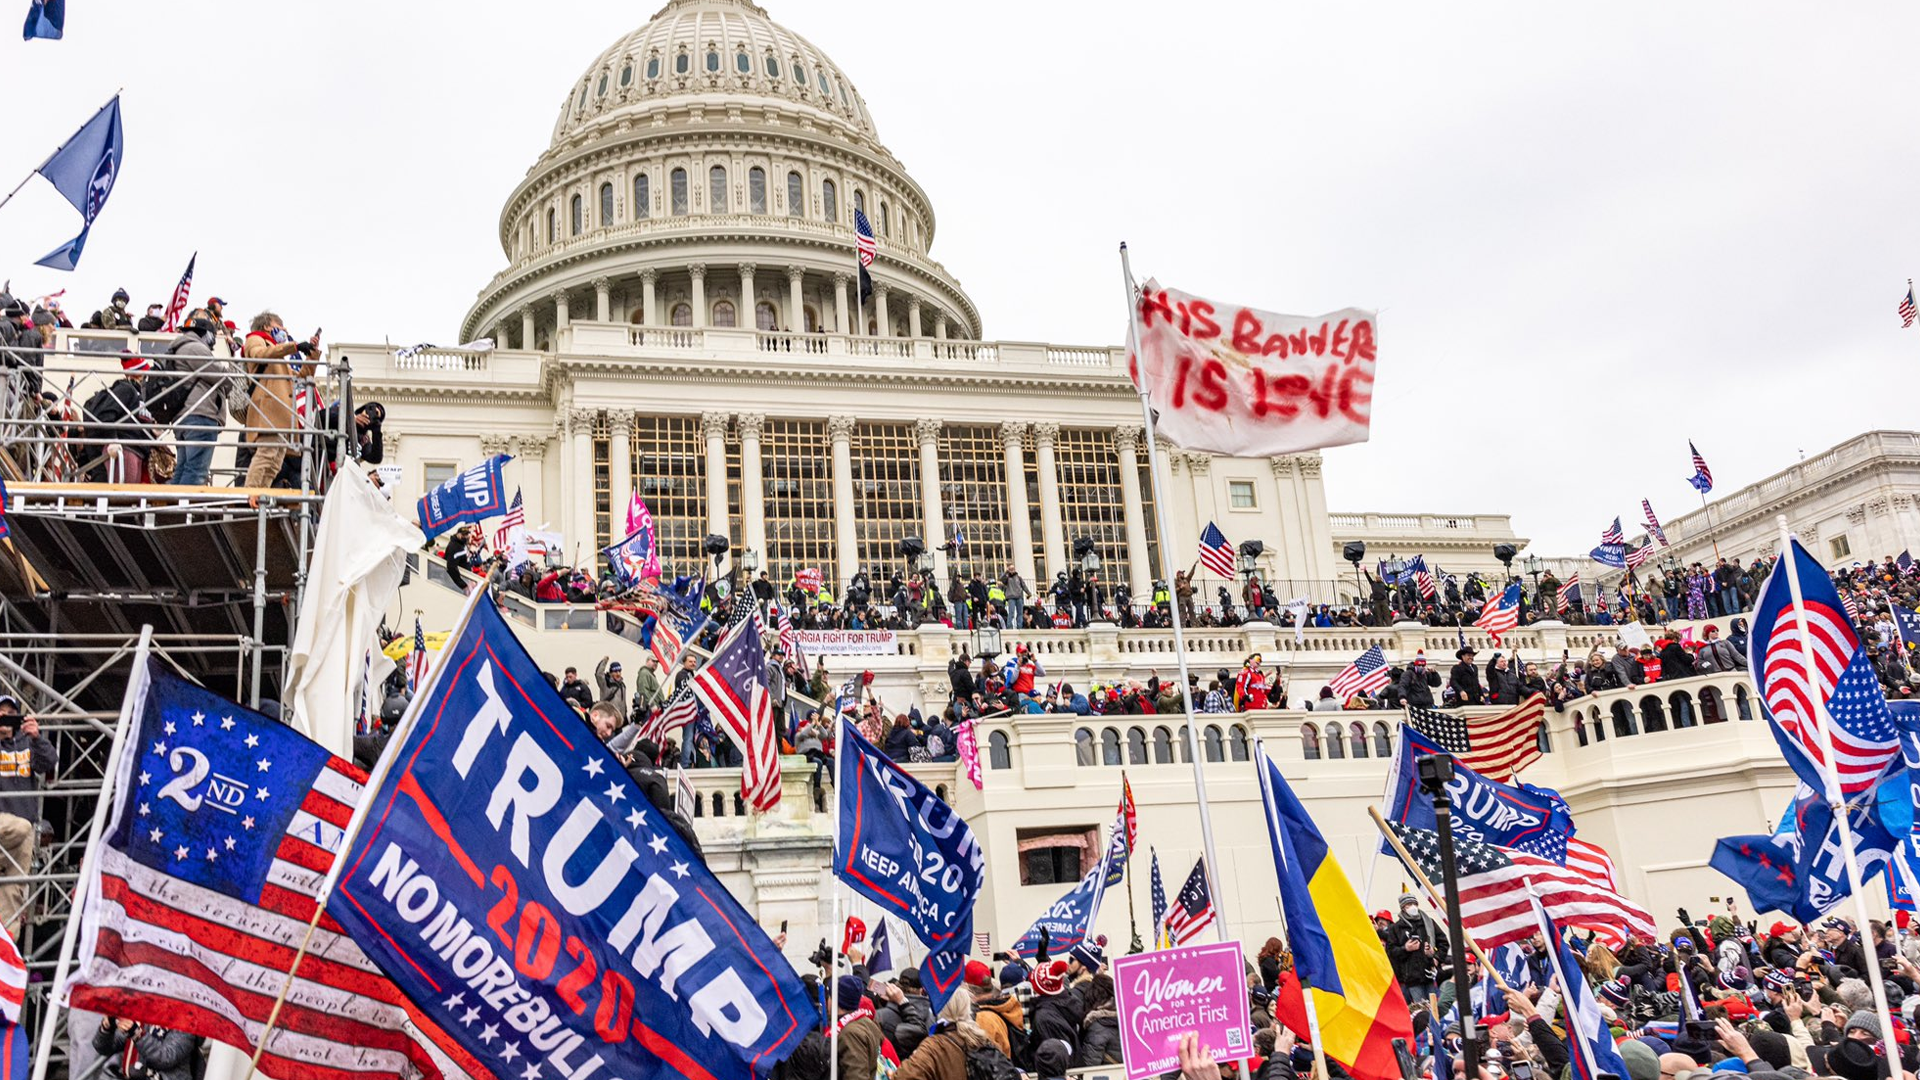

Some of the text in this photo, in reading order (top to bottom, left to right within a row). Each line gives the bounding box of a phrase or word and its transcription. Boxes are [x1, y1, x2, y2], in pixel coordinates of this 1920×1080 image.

[1141, 284, 1222, 340] HIS
[1172, 355, 1229, 412] IS
[790, 632, 893, 643] EORGIA FIGHT FOR TRUMP
[1442, 770, 1541, 832] RUMP
[451, 658, 769, 1050] TRUMP
[861, 843, 900, 879] KEEP
[149, 878, 180, 902] the
[200, 902, 292, 946] security
[312, 933, 341, 960] of
[483, 864, 636, 1044] 2020
[1133, 966, 1227, 1006] Women
[1171, 999, 1186, 1008] FOR
[291, 991, 358, 1016] people
[372, 1008, 388, 1026] to
[1141, 1008, 1196, 1036] America
[1198, 1004, 1229, 1025] First
[299, 1047, 332, 1062] not
